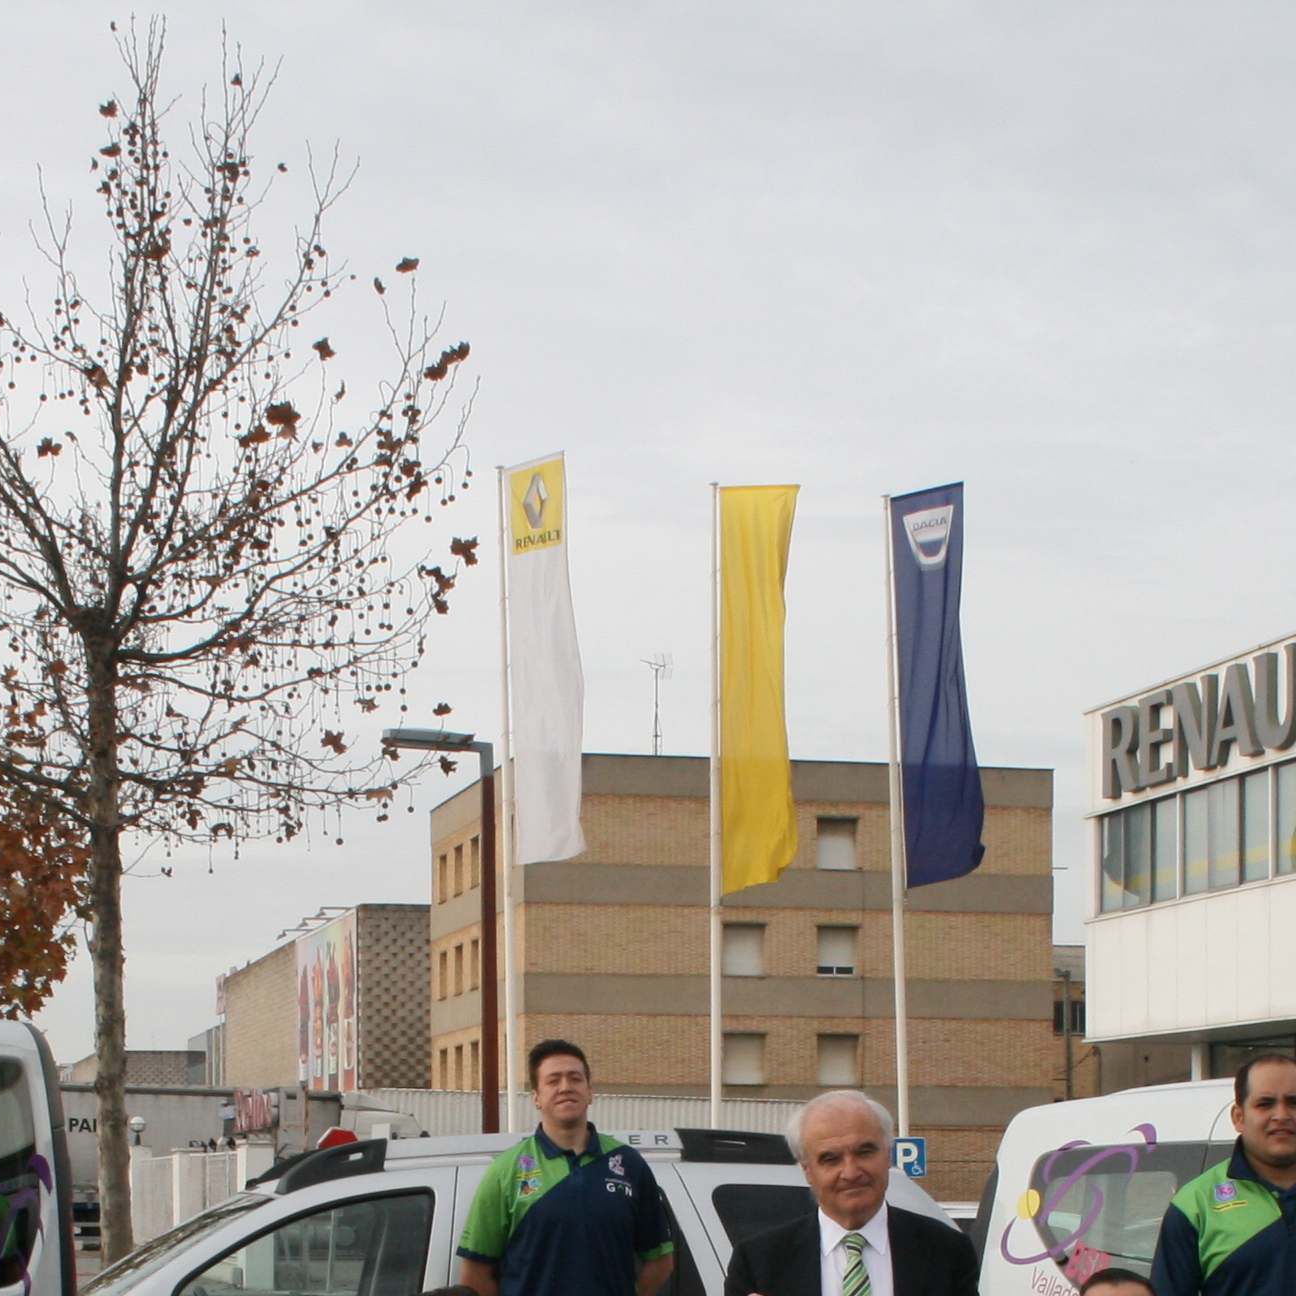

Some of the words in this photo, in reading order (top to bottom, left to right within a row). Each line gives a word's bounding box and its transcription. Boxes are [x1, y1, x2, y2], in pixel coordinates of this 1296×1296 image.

[912, 516, 947, 531] DACIA
[515, 528, 561, 550] RENAULT
[896, 1142, 918, 1170] P
